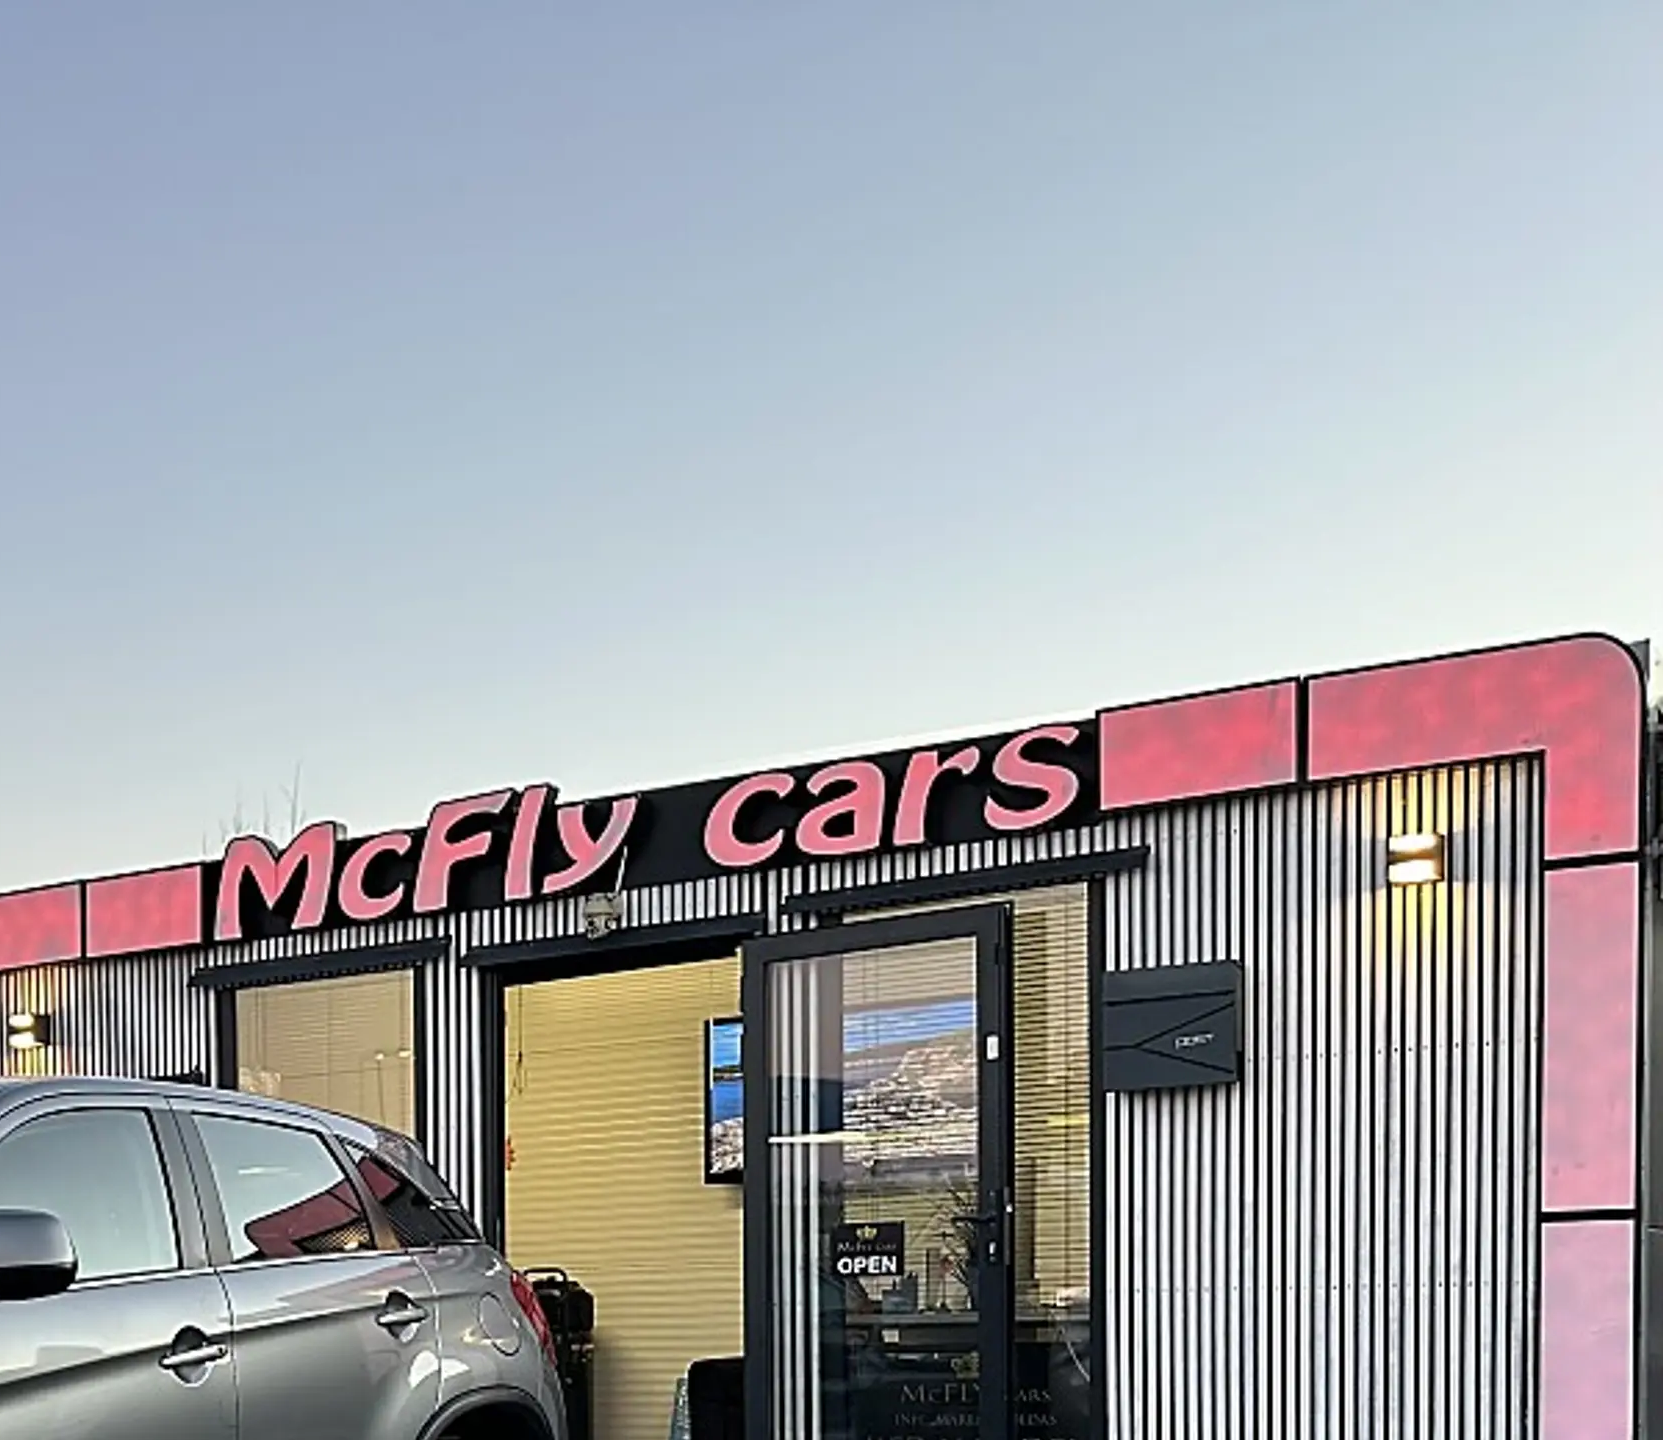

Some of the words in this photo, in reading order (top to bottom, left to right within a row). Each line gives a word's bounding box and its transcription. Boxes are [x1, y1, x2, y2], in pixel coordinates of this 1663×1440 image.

[215, 780, 640, 940] McFly
[703, 725, 1080, 868] cars
[837, 1255, 897, 1274] OPEN
